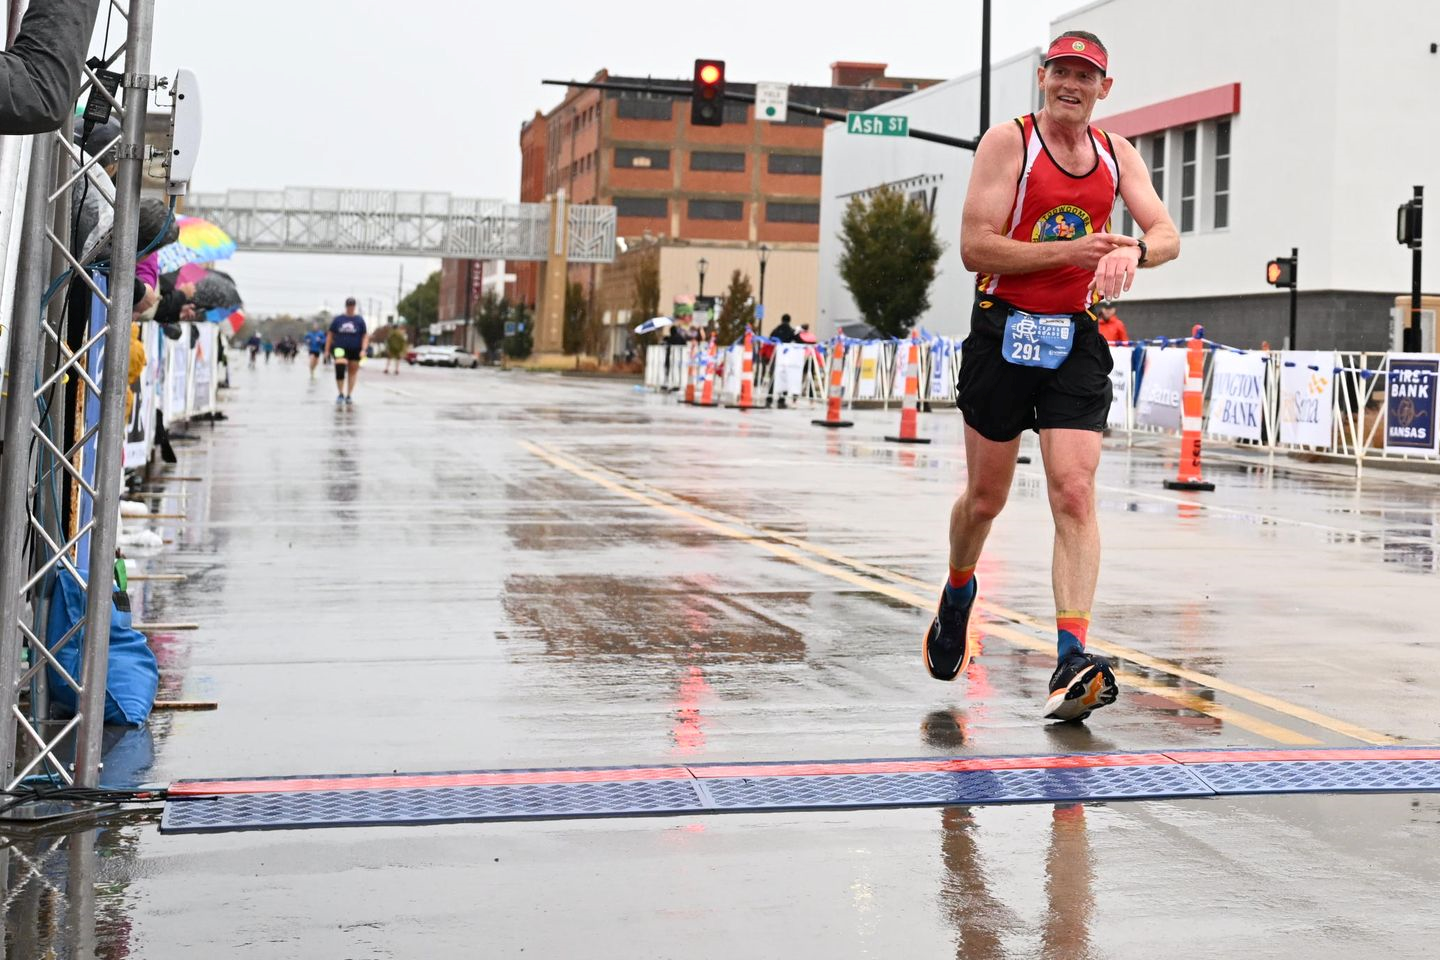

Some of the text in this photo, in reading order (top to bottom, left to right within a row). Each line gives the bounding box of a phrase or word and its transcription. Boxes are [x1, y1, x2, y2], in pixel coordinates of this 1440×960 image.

[851, 116, 905, 134] Ash ST
[1011, 342, 1041, 361] 291
[1391, 383, 1429, 398] BANK
[1222, 399, 1258, 427] BANK
[1389, 426, 1427, 439] KANSAS
